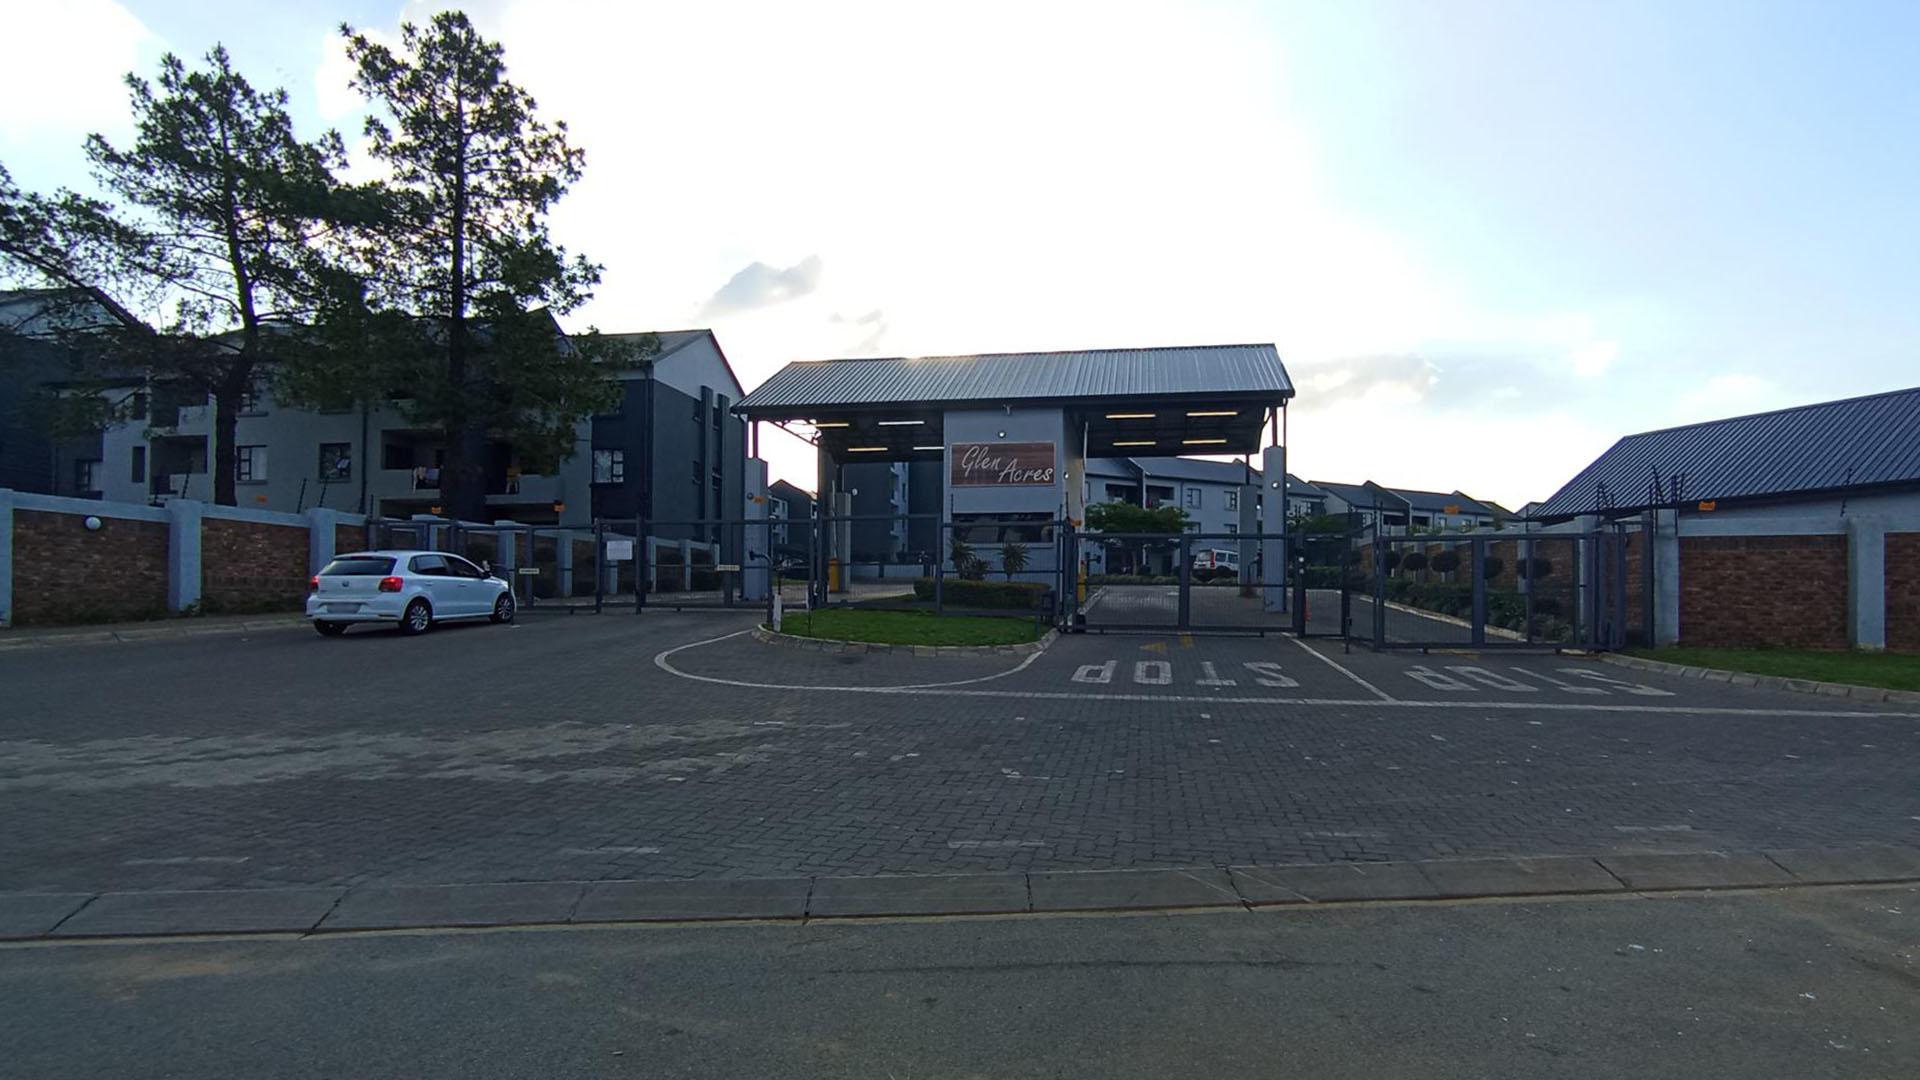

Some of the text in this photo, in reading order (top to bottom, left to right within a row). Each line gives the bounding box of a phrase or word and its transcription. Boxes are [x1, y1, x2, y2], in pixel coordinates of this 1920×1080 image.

[961, 445, 1054, 483] Glen Acres
[1070, 659, 1300, 688] STOP
[1403, 665, 1677, 696] STOP
